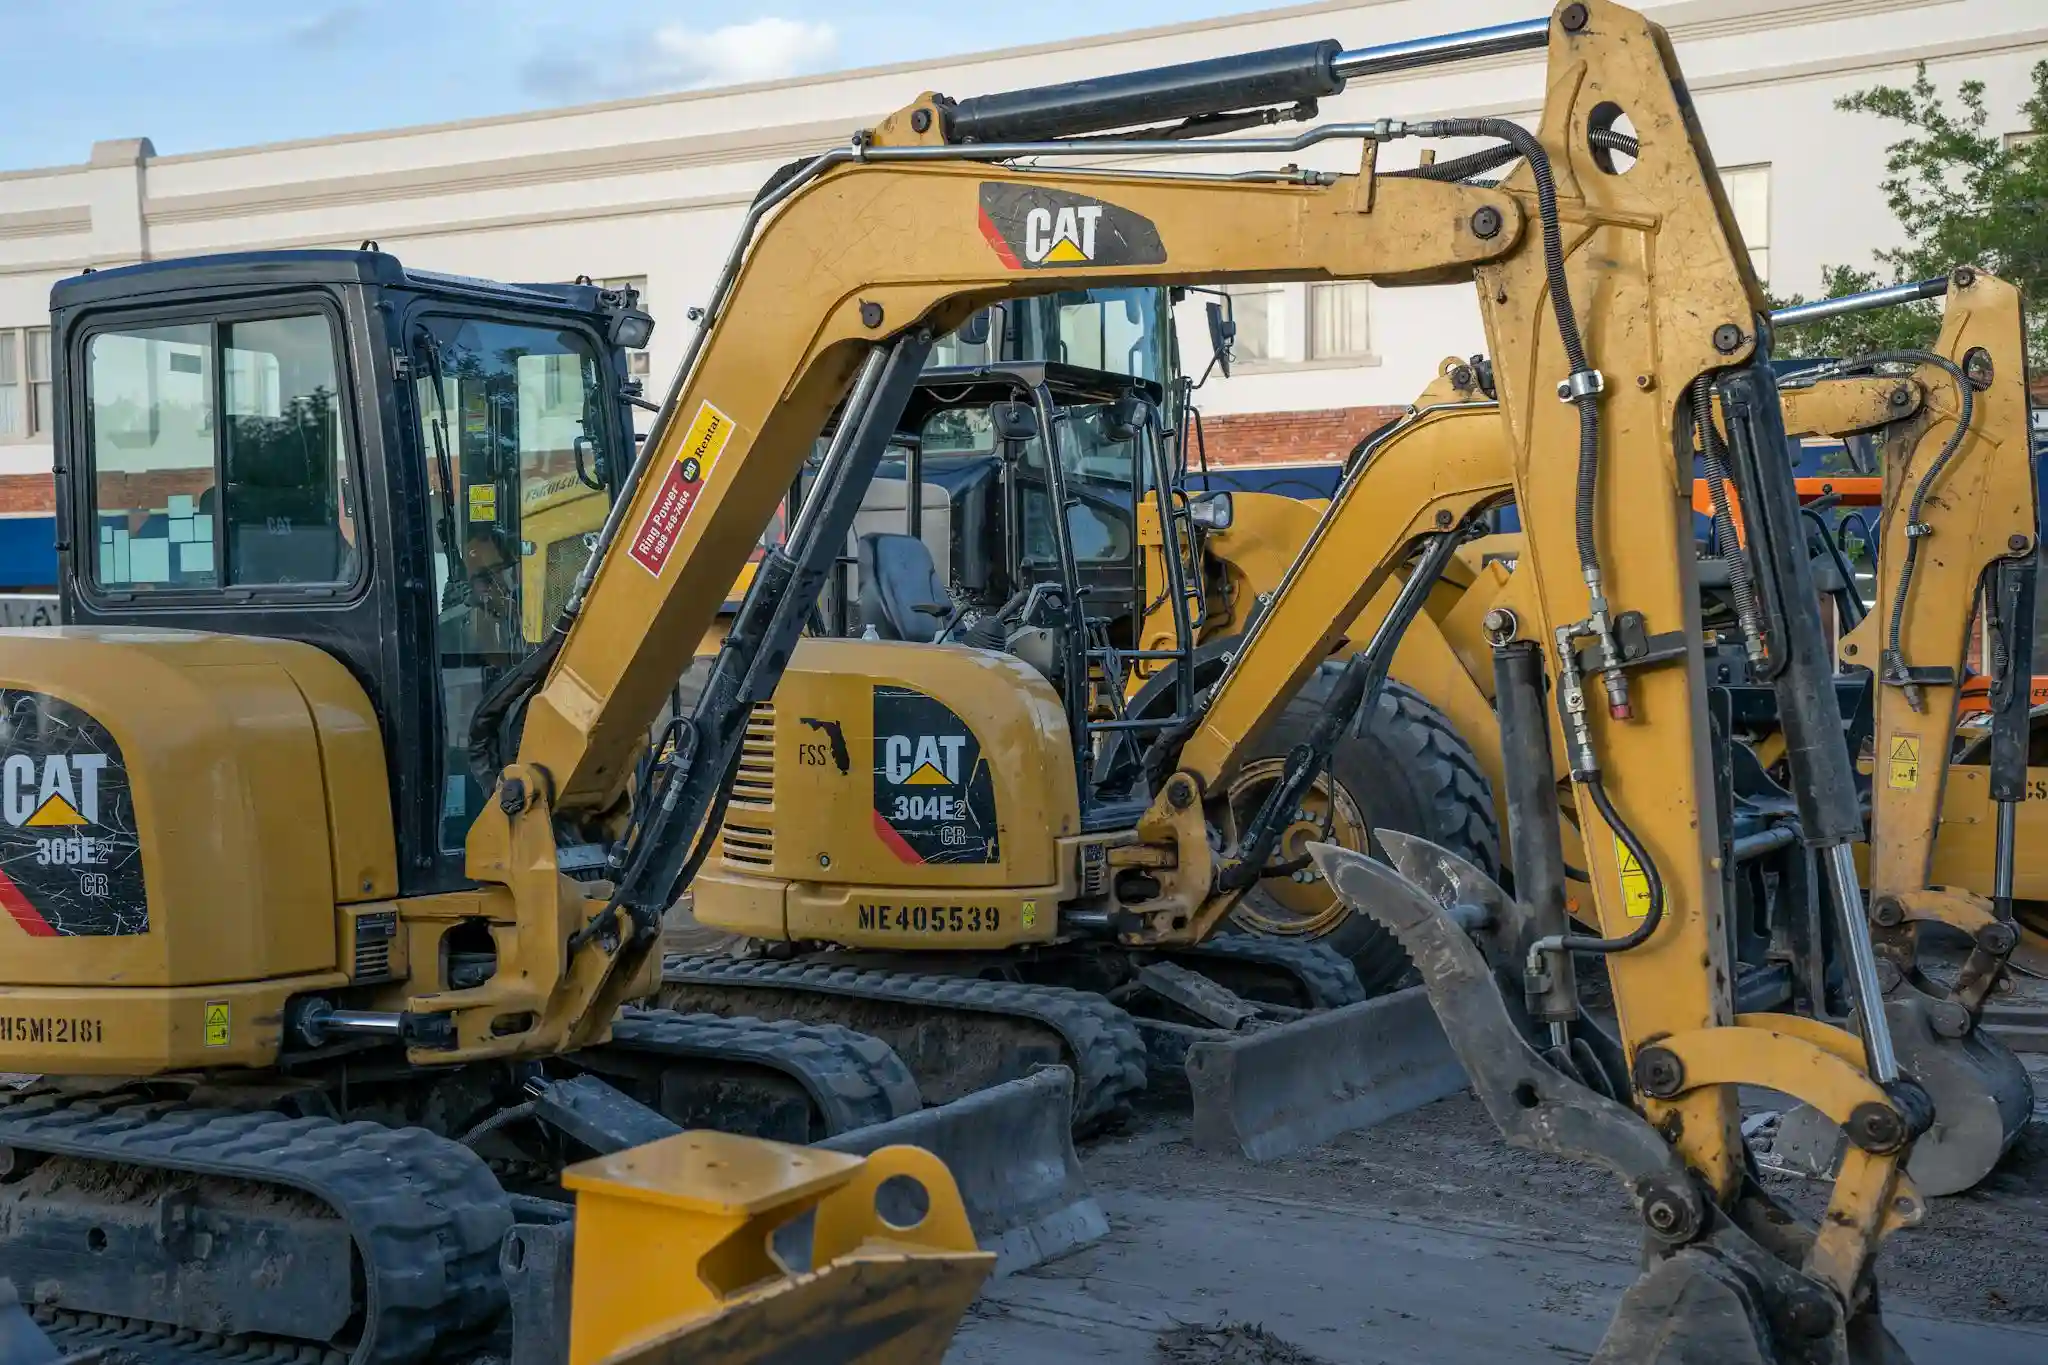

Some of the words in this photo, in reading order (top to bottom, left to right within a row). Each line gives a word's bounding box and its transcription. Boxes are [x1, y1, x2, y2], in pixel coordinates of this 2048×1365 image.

[1026, 206, 1102, 262] CAT
[694, 415, 721, 459] Rental
[684, 460, 697, 481] CAT
[638, 527, 661, 556] Ring
[653, 485, 680, 527] Power
[651, 554, 659, 562] 1
[655, 535, 668, 554] 888
[799, 743, 826, 766] FSS
[886, 735, 965, 784] CAT
[3, 754, 107, 828] CAT
[894, 795, 966, 820] 304E2
[940, 825, 967, 845] CR
[36, 837, 109, 865] 305E2
[80, 873, 109, 896] CR
[858, 903, 1000, 932] ME405539
